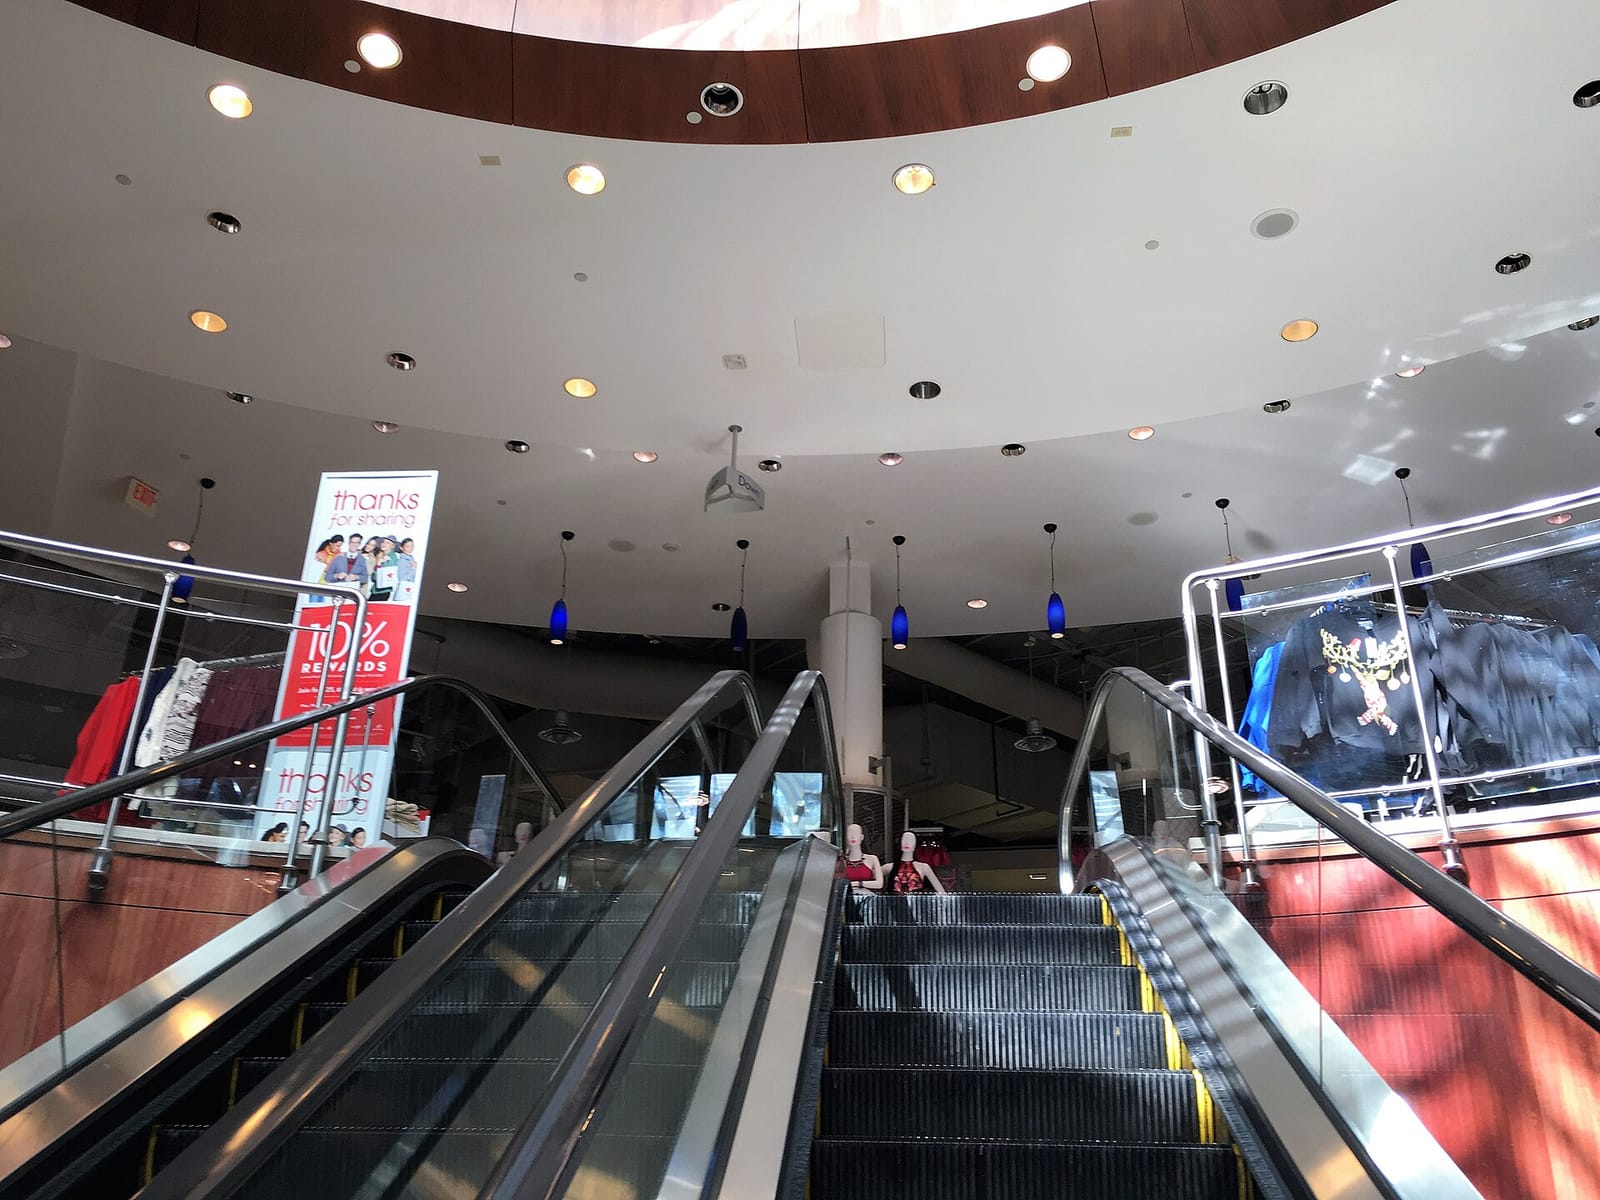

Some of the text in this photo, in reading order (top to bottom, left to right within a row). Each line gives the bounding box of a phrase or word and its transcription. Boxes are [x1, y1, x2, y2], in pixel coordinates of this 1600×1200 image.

[333, 489, 420, 511] thanks
[327, 512, 416, 530] for sharing
[308, 620, 390, 661] 10%
[303, 796, 369, 815] shring
